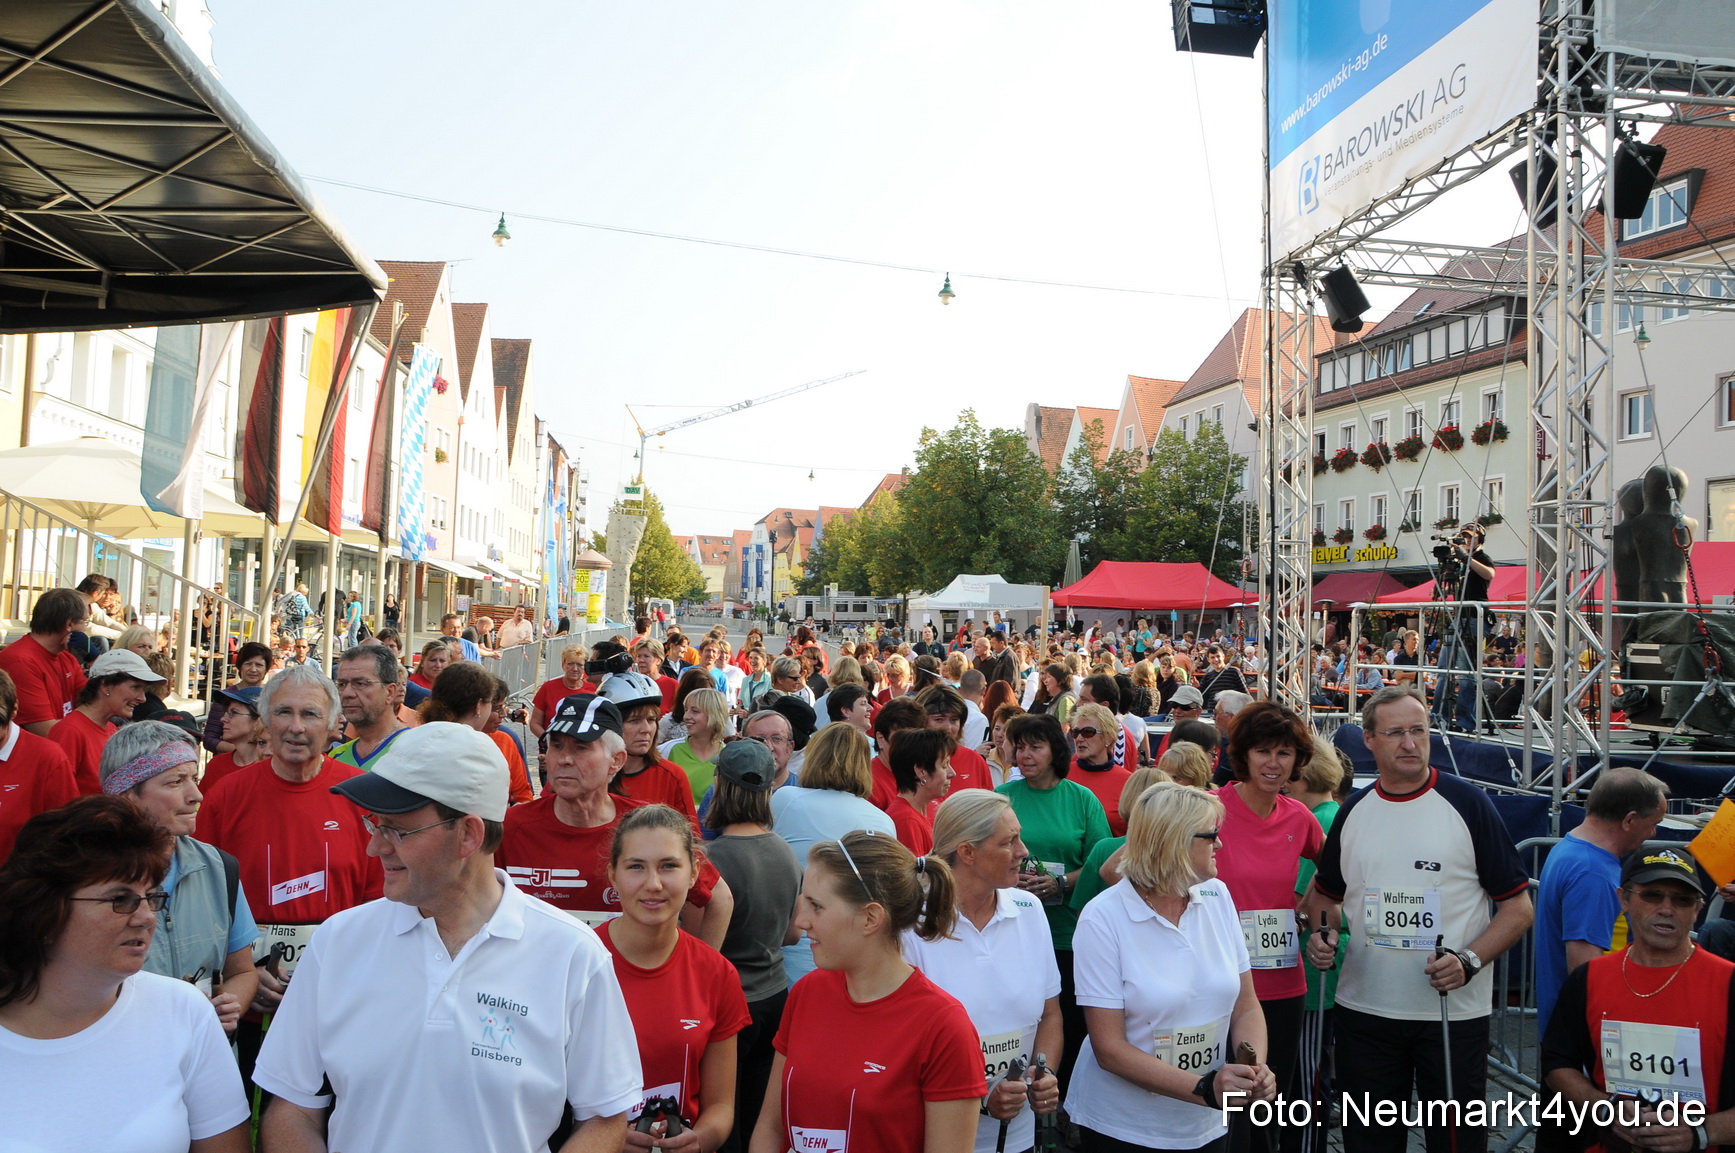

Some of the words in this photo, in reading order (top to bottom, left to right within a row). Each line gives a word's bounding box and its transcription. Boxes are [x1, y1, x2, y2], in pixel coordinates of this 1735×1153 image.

[1280, 33, 1388, 134] www.barowski-ag.de
[1323, 89, 1425, 182] BAROWSKI
[1430, 63, 1467, 114] AG
[1376, 146, 1393, 163] und
[1394, 104, 1464, 153] Mediensysteme
[1354, 542, 1398, 562] schuhe
[286, 880, 310, 895] DEHN
[1383, 891, 1425, 905] Wolfram
[1257, 914, 1278, 928] Lydia
[1366, 909, 1372, 918] N
[1385, 910, 1434, 929] 8046
[271, 924, 296, 937] Hans
[1261, 931, 1294, 949] 8047
[476, 992, 529, 1017] Walking
[981, 1038, 1020, 1055] Annette
[1176, 1032, 1206, 1046] Zenta
[471, 1046, 523, 1067] Dilsberg
[1177, 1042, 1221, 1071] 8031
[1605, 1047, 1612, 1058] N
[1629, 1051, 1690, 1078] 8101
[802, 1137, 829, 1149] DEHN
